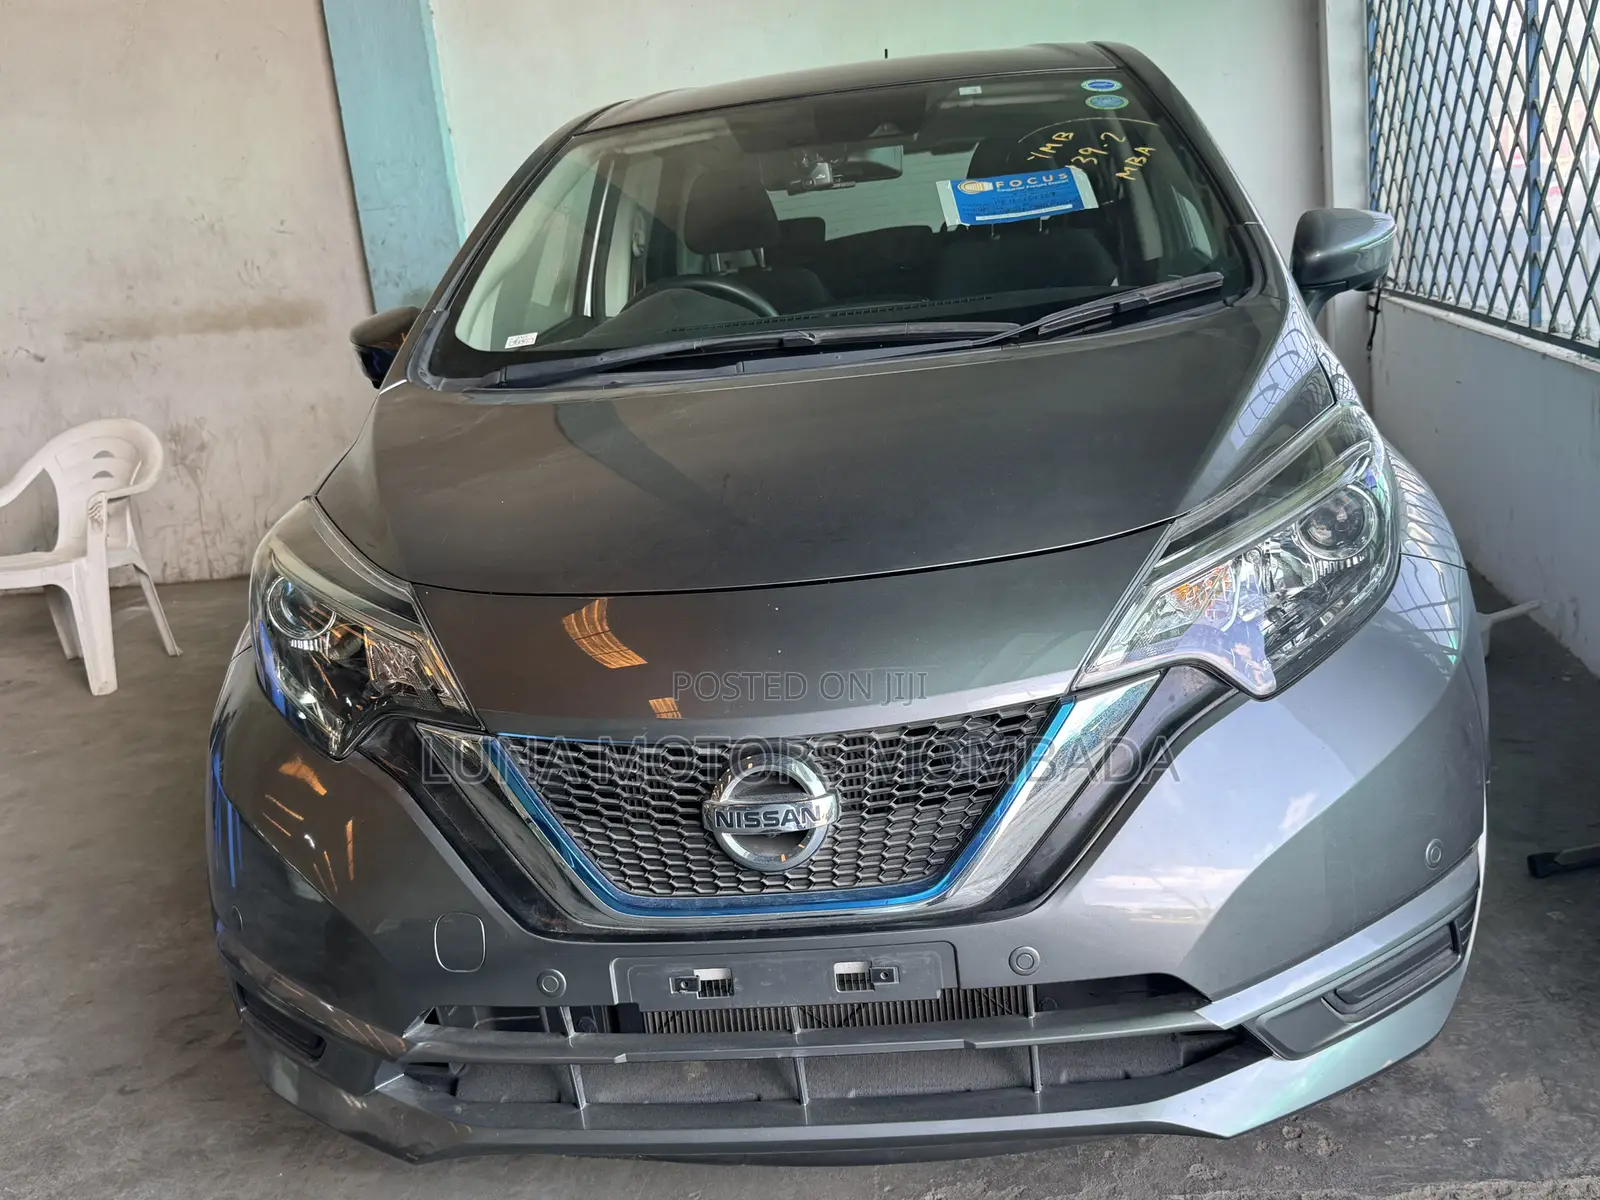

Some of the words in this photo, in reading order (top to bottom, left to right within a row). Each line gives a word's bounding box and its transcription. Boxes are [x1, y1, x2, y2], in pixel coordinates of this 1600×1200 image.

[1115, 147, 1156, 180] MBA
[995, 172, 1068, 189] FOCUS
[714, 802, 821, 829] NISSAN
